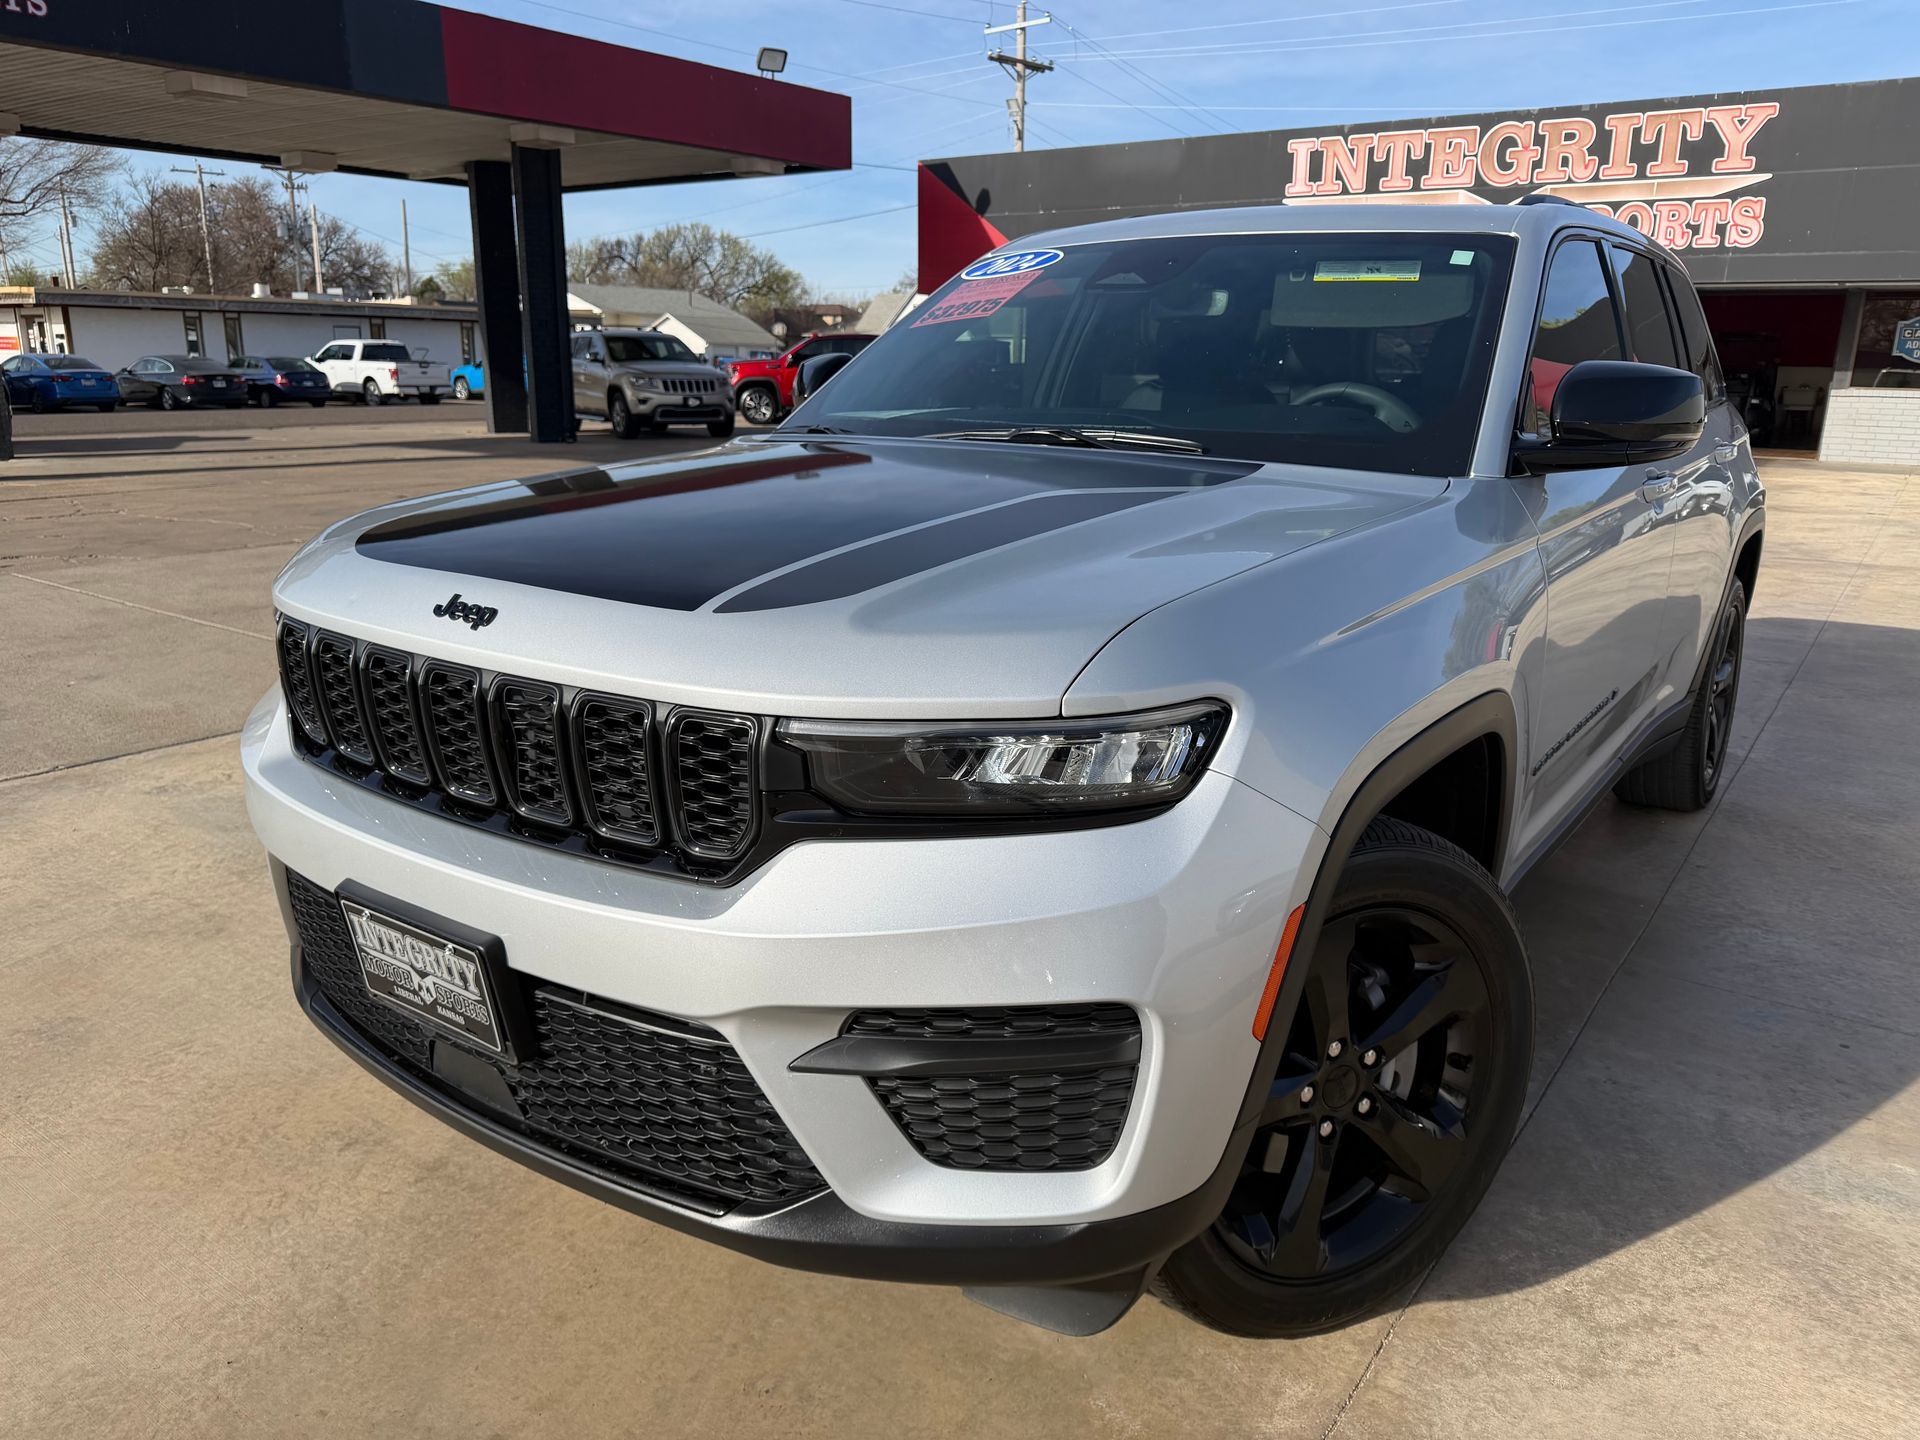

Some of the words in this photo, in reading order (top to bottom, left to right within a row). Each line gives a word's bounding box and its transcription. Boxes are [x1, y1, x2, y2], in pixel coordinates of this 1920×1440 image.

[1285, 102, 1780, 197] INTEGRITY
[970, 252, 1055, 277] 2024
[920, 297, 1008, 321] $32975
[433, 593, 499, 631] Jeep
[348, 911, 481, 997] INTEGRITY
[361, 952, 415, 990] MOTOR
[434, 984, 490, 1025] SPORTS
[436, 1004, 466, 1025] KANSAS
